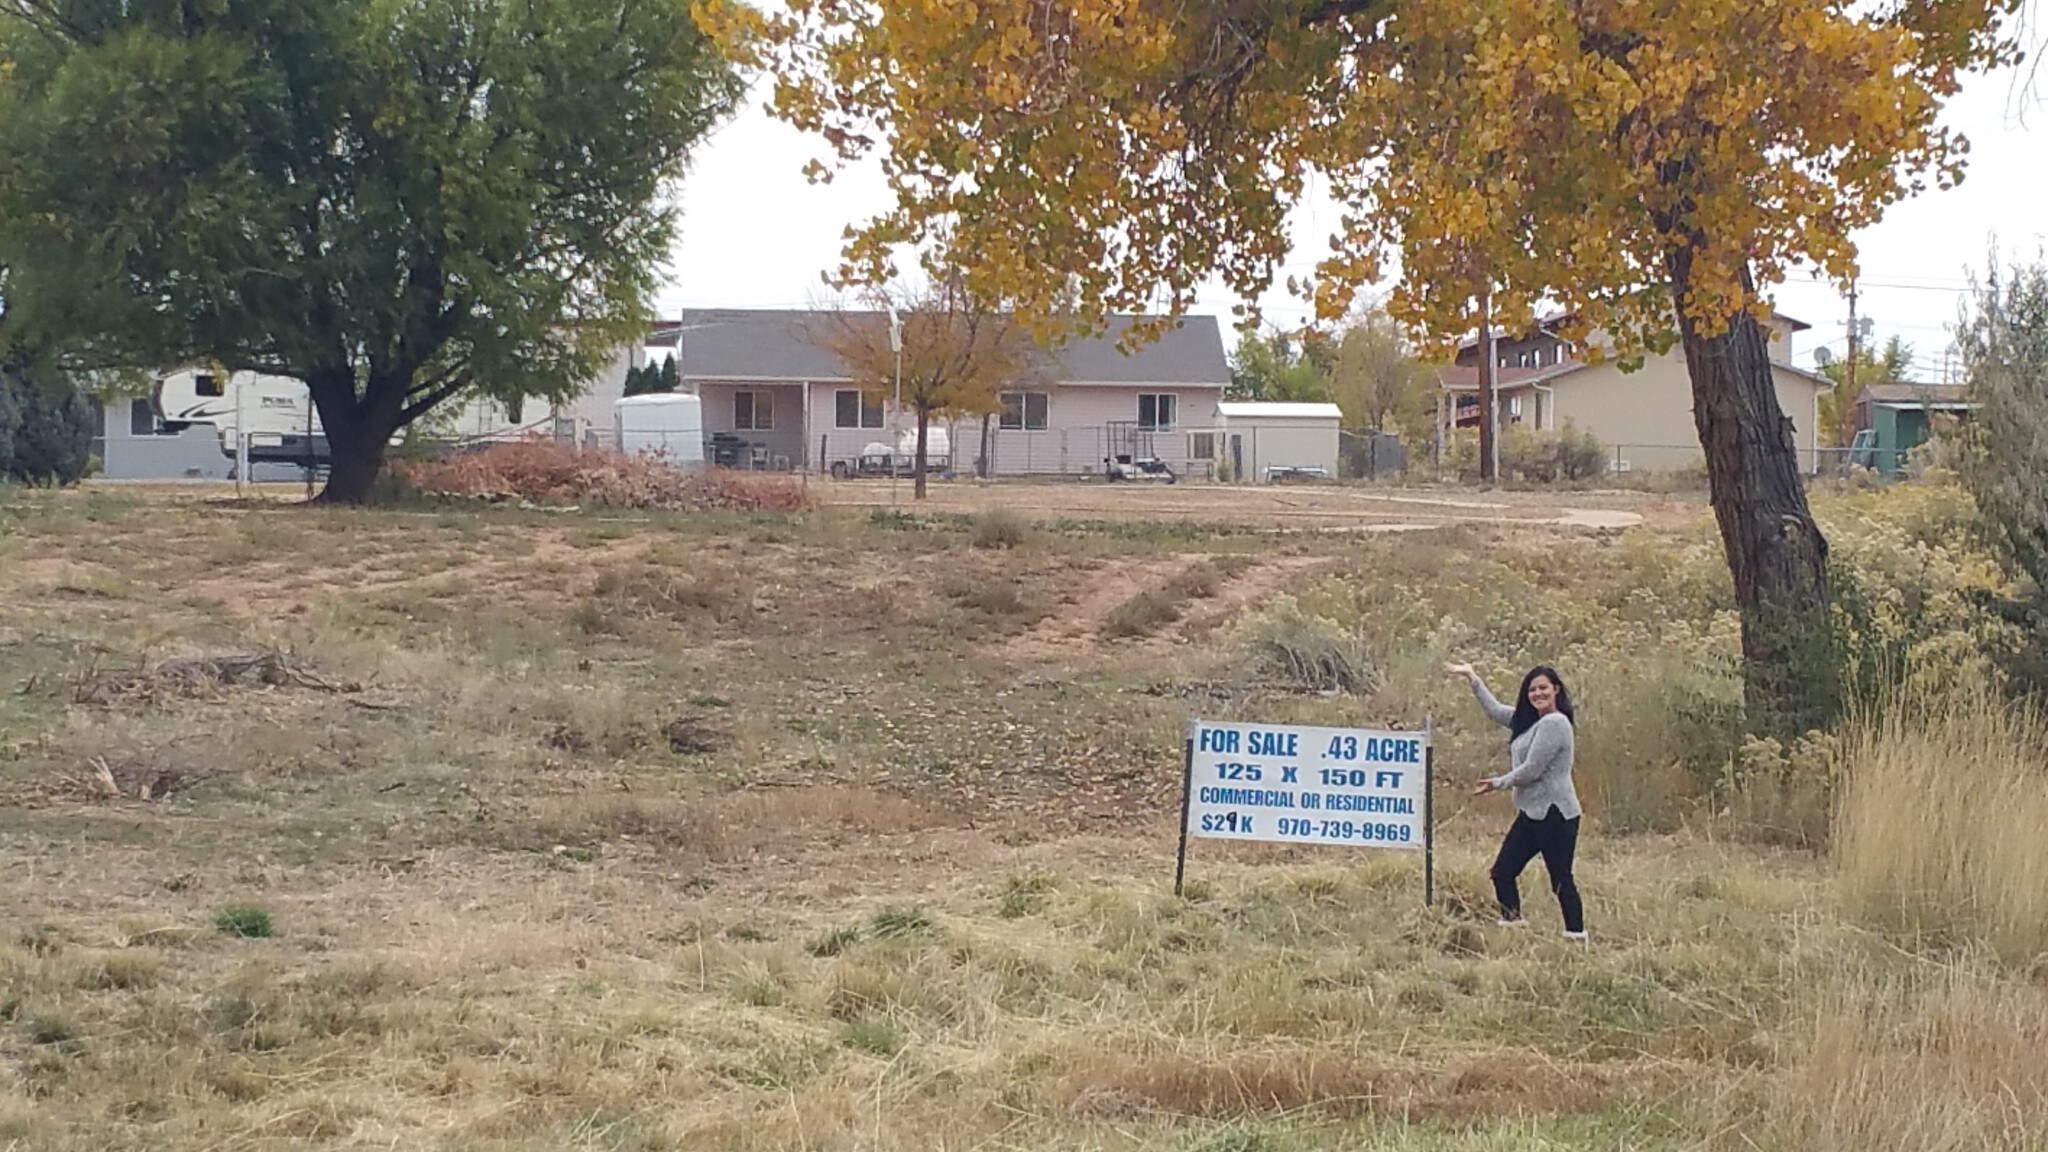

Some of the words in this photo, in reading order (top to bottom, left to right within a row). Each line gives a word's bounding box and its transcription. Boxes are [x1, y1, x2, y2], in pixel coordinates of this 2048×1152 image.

[1200, 728, 1240, 753] FOR
[1247, 731, 1298, 757] SALE
[1321, 736, 1358, 760] .43
[1365, 738, 1420, 763] ACRE
[1215, 763, 1262, 781] 125
[1281, 766, 1298, 784] X
[1318, 768, 1366, 787] 150
[1375, 771, 1404, 789] FT
[1200, 786, 1295, 808] COMMERCIAL
[1300, 792, 1321, 810] OR
[1325, 794, 1415, 814] RESIDENTIAL
[1277, 818, 1411, 842] 970-739-8969
